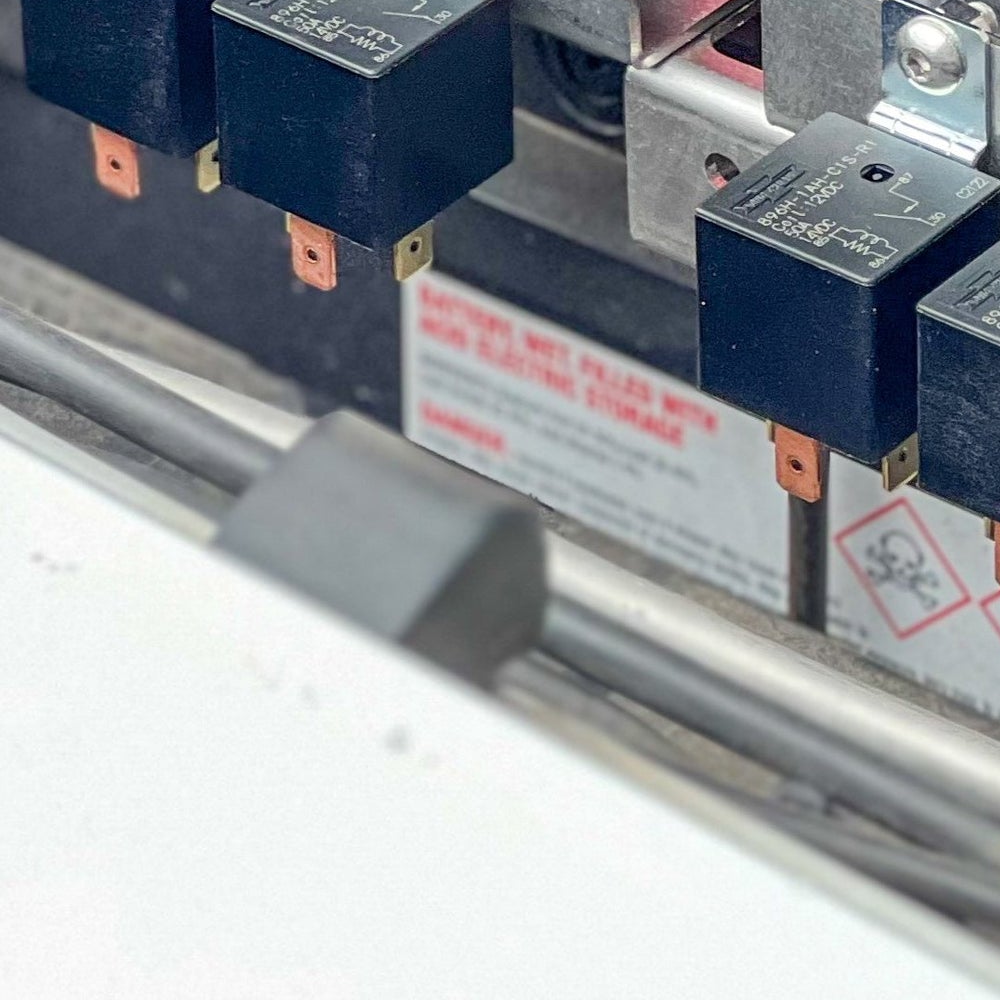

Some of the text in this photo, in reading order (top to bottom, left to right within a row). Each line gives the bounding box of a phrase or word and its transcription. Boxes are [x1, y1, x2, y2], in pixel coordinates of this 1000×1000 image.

[296, 18, 323, 34] 50A
[309, 16, 346, 39] 14VDC
[758, 139, 879, 226] 896H-1AH-C1S-R1
[784, 221, 812, 238] 50A
[799, 218, 837, 243] 14VDC
